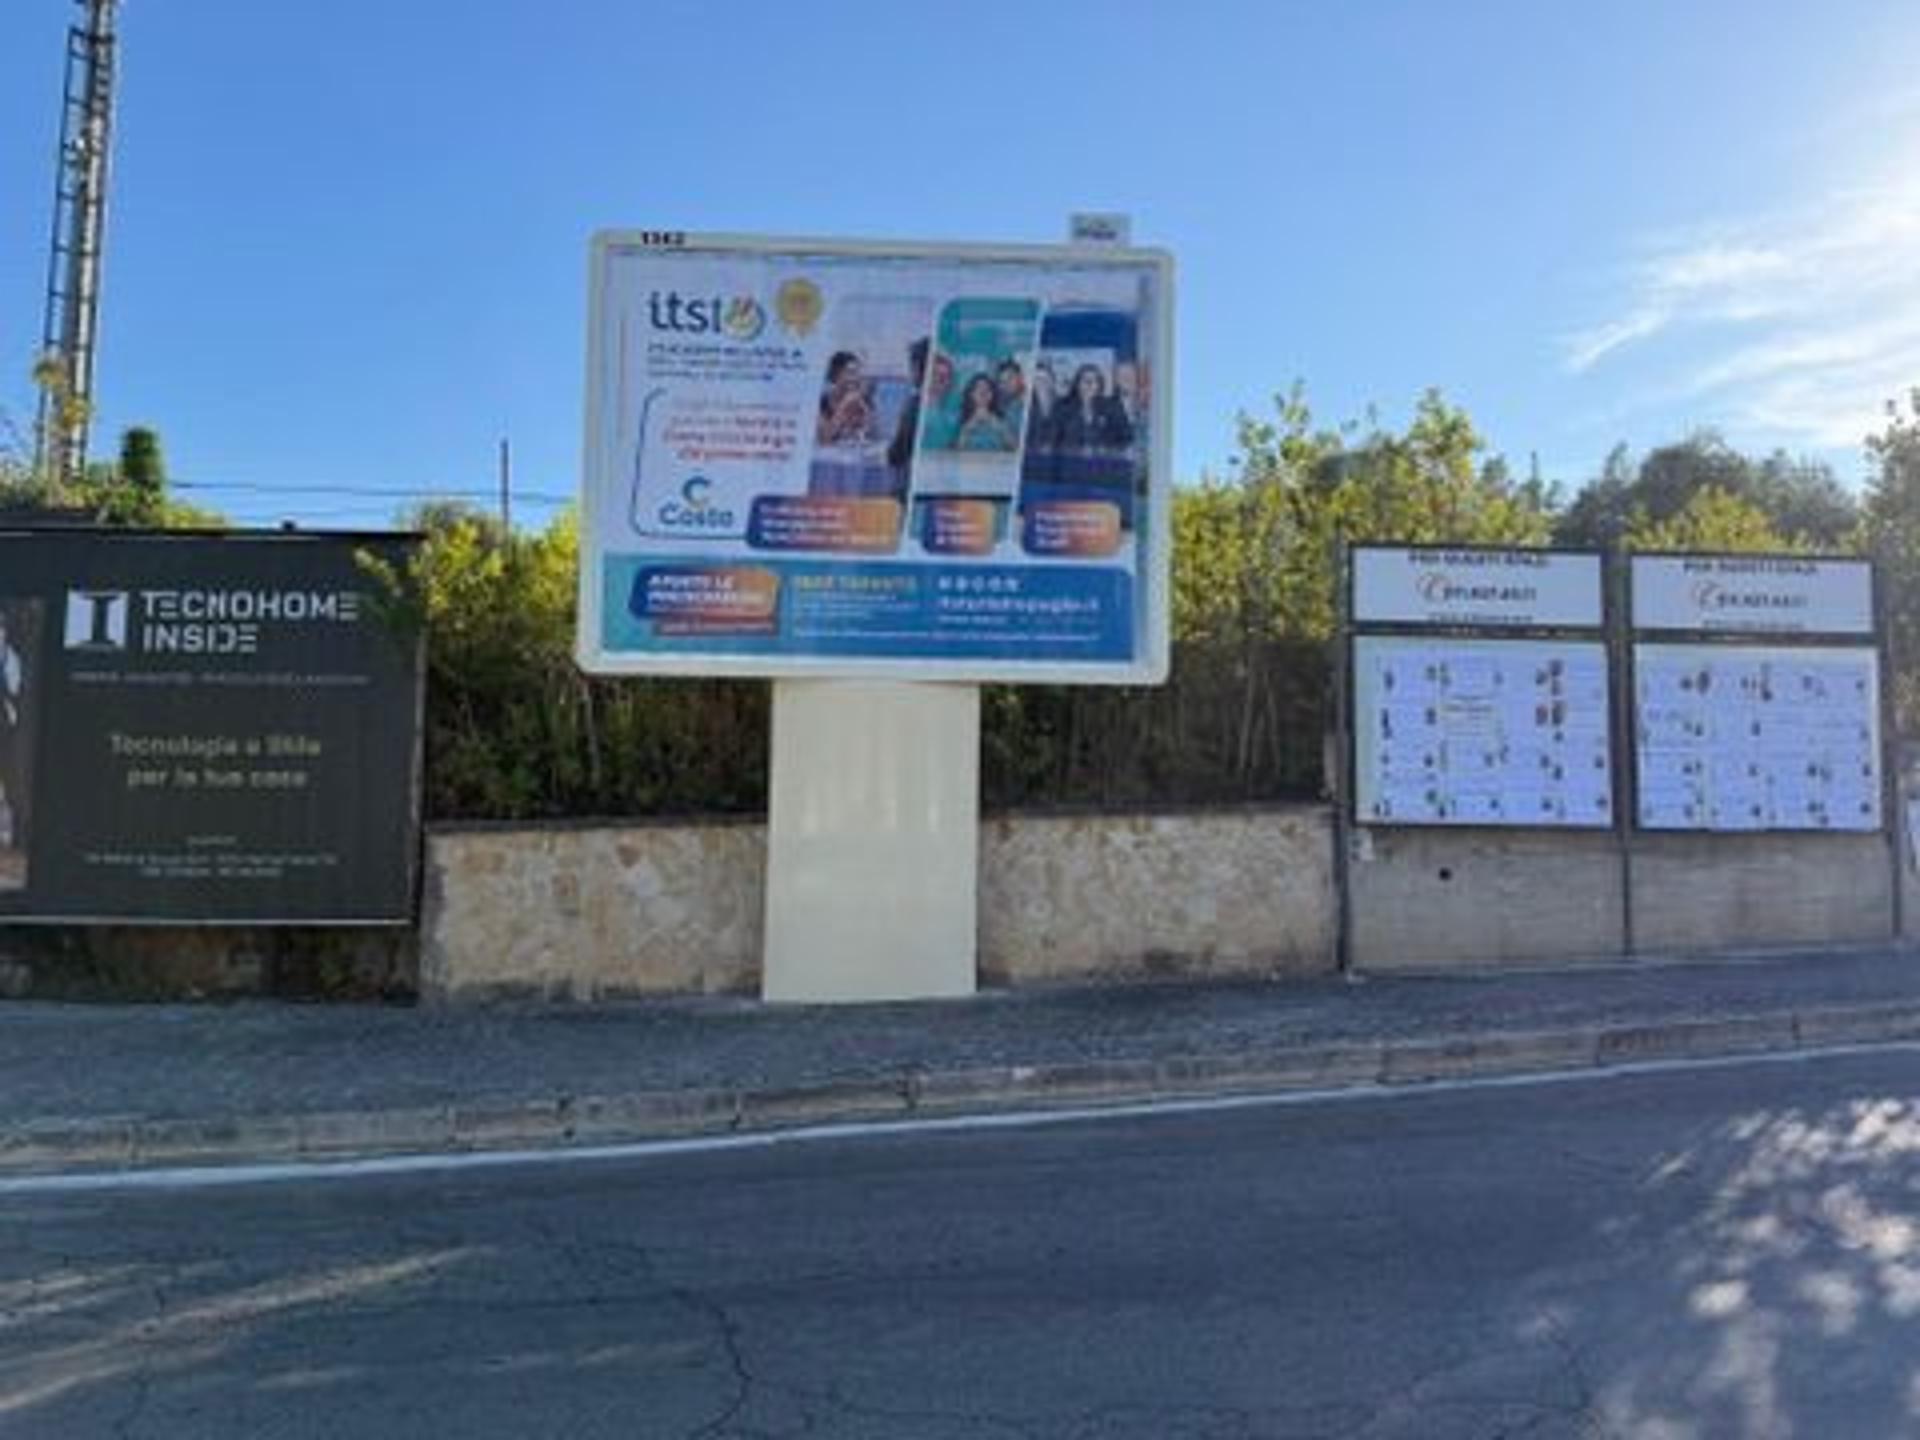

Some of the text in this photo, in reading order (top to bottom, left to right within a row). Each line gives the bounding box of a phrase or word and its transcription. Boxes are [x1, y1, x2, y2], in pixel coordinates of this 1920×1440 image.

[658, 503, 734, 527] Costa
[140, 590, 359, 621] TECNOHOME
[142, 624, 258, 653] INSIDE
[110, 732, 239, 759] Tecnologia
